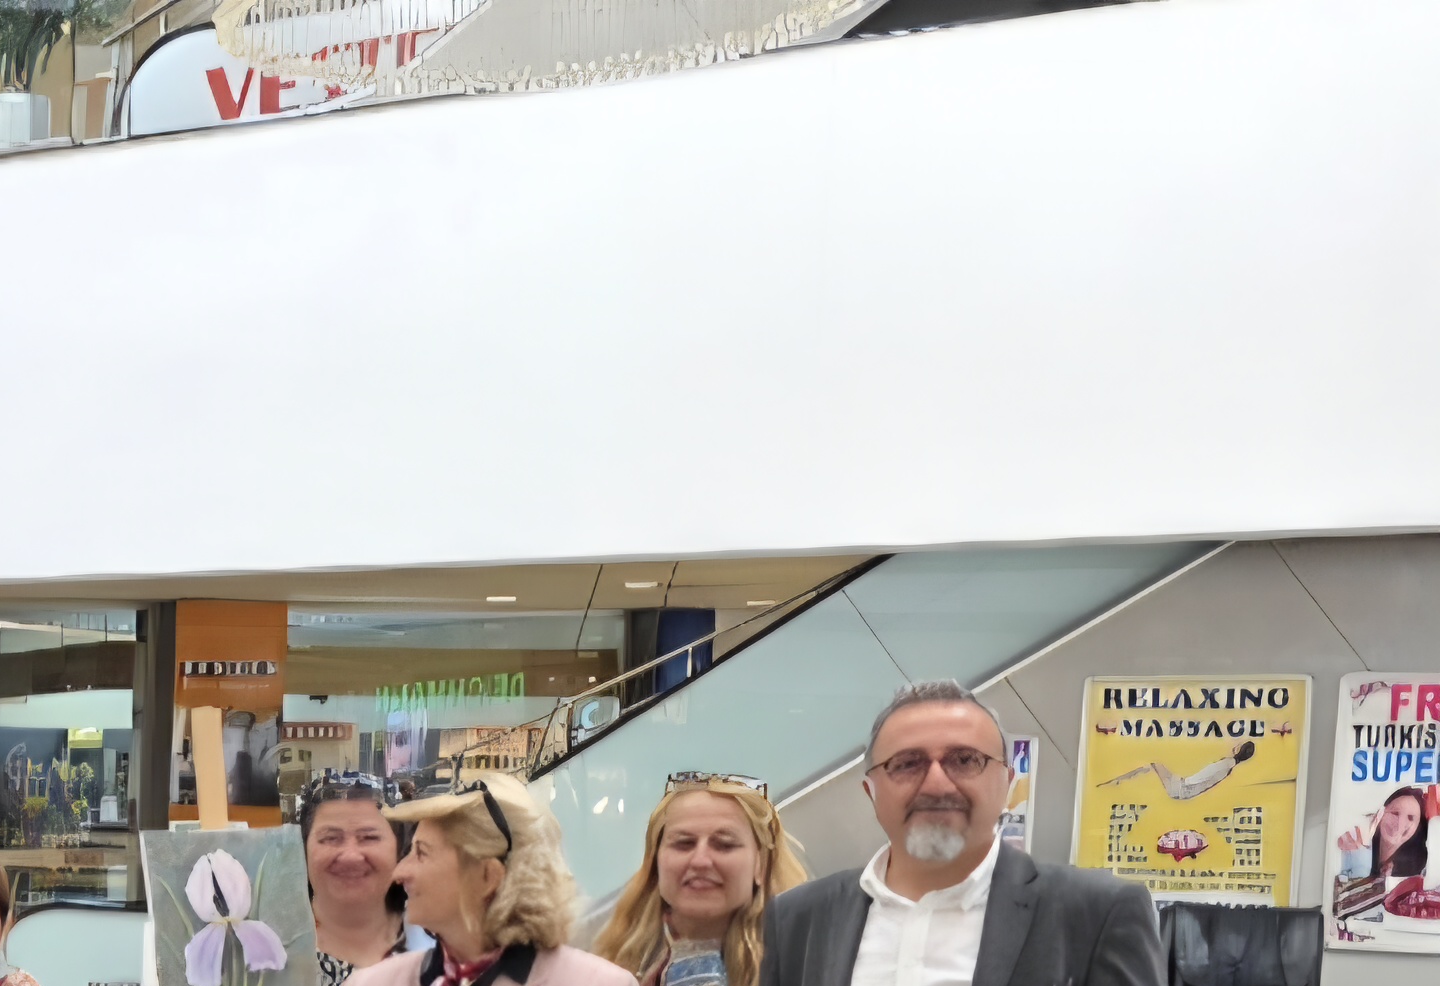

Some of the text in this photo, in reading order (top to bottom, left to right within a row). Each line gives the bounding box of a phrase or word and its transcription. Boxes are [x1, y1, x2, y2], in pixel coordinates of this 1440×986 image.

[1102, 687, 1290, 710] RELAXING
[1120, 718, 1266, 738] MASSAGE
[1351, 750, 1440, 784] SUPE
